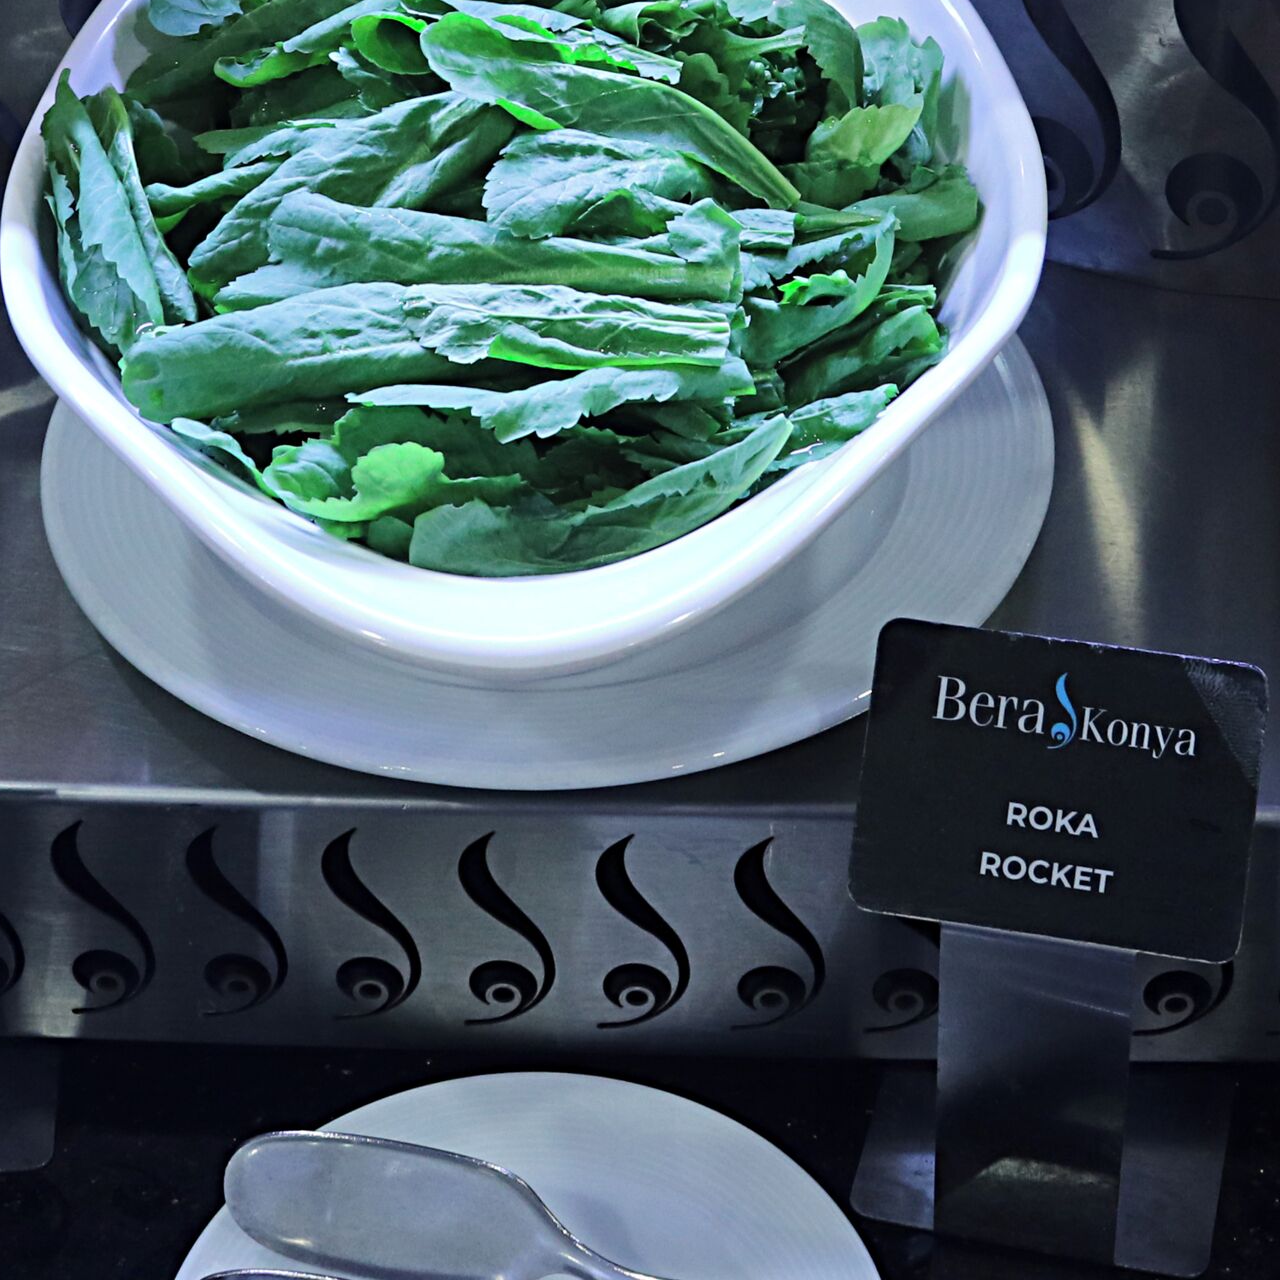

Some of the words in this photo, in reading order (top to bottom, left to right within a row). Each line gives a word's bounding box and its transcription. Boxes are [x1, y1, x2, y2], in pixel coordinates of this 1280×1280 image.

[932, 675, 1045, 734] Bera
[1079, 706, 1197, 759] Konya
[1006, 801, 1099, 838] ROKA
[979, 851, 1114, 893] ROCKET
